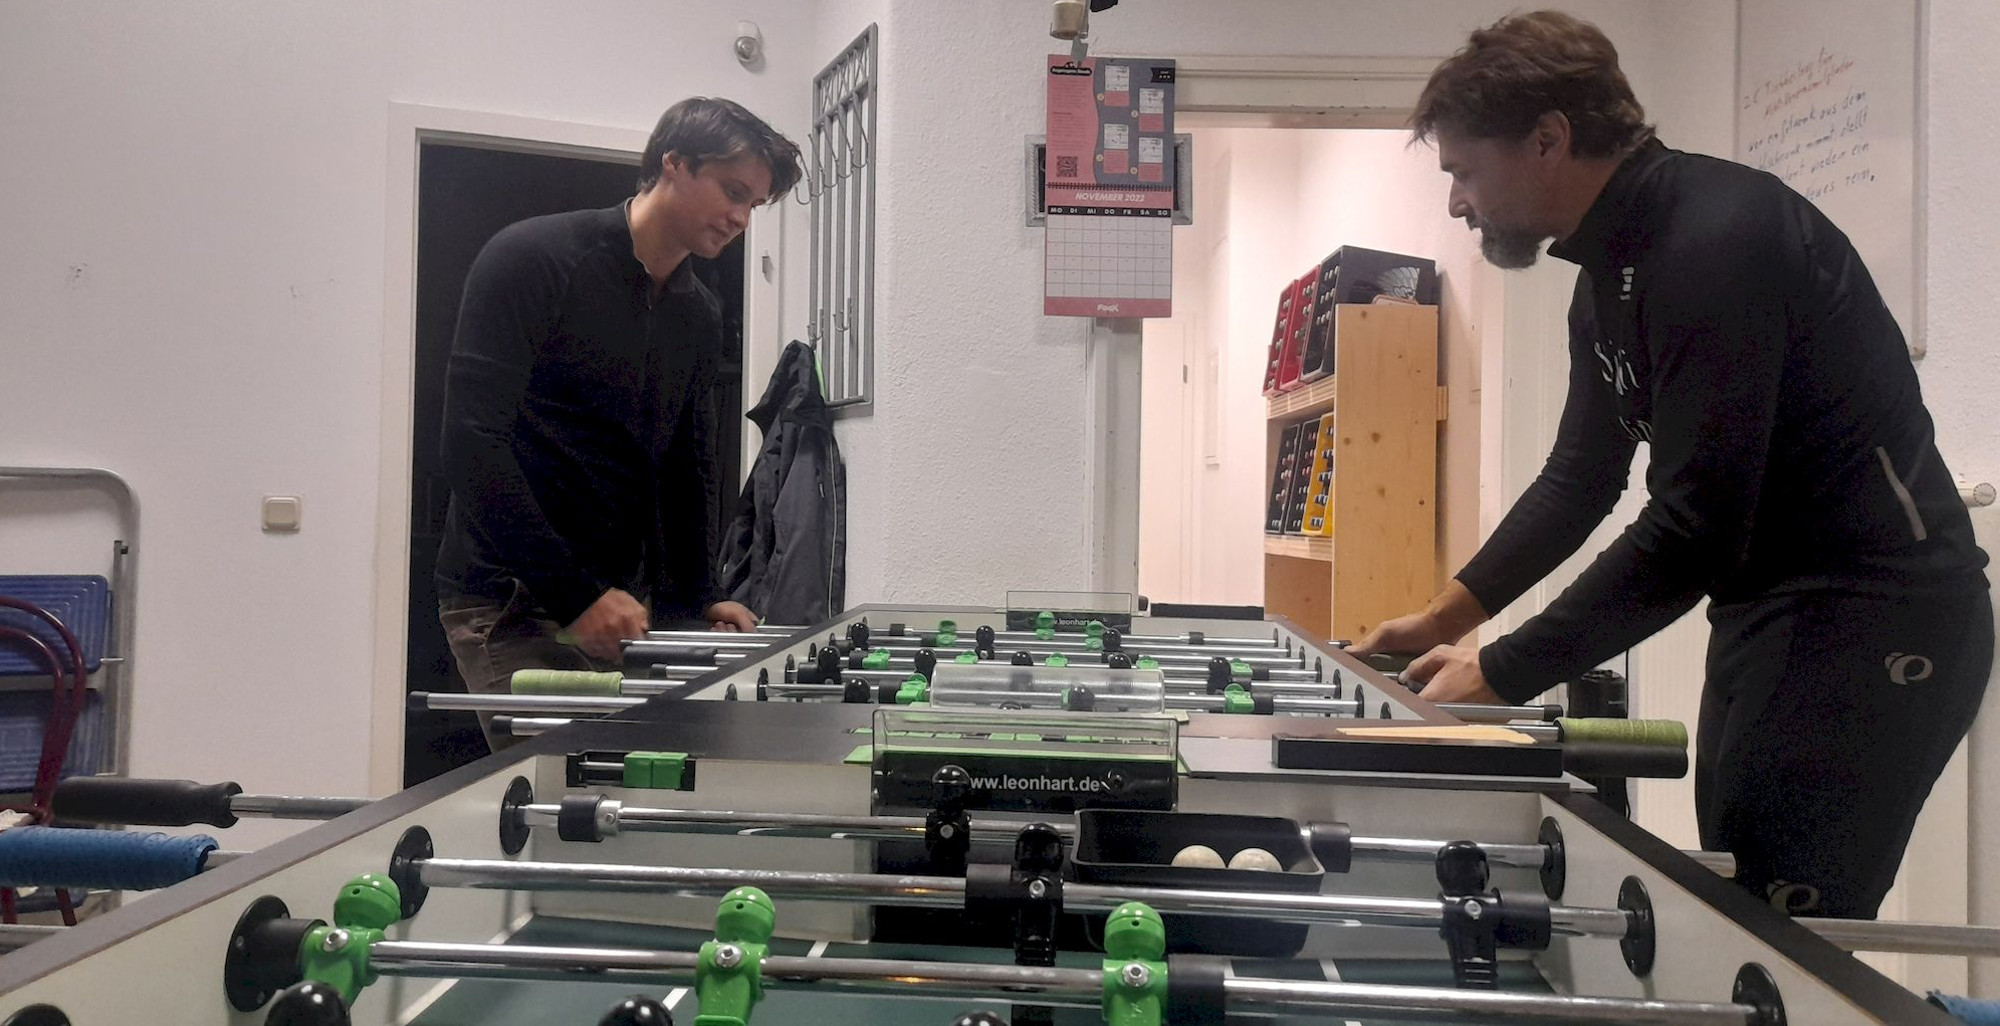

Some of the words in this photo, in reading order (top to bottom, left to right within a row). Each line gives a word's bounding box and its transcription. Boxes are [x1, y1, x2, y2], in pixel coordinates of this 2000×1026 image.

[1819, 102, 1838, 121] aus
[1843, 84, 1866, 111] dem
[1851, 143, 1870, 157] ein
[1075, 193, 1123, 202] NOVEMBER
[1124, 194, 1145, 202] 2022
[970, 774, 1100, 792] ww.leonhart.de
